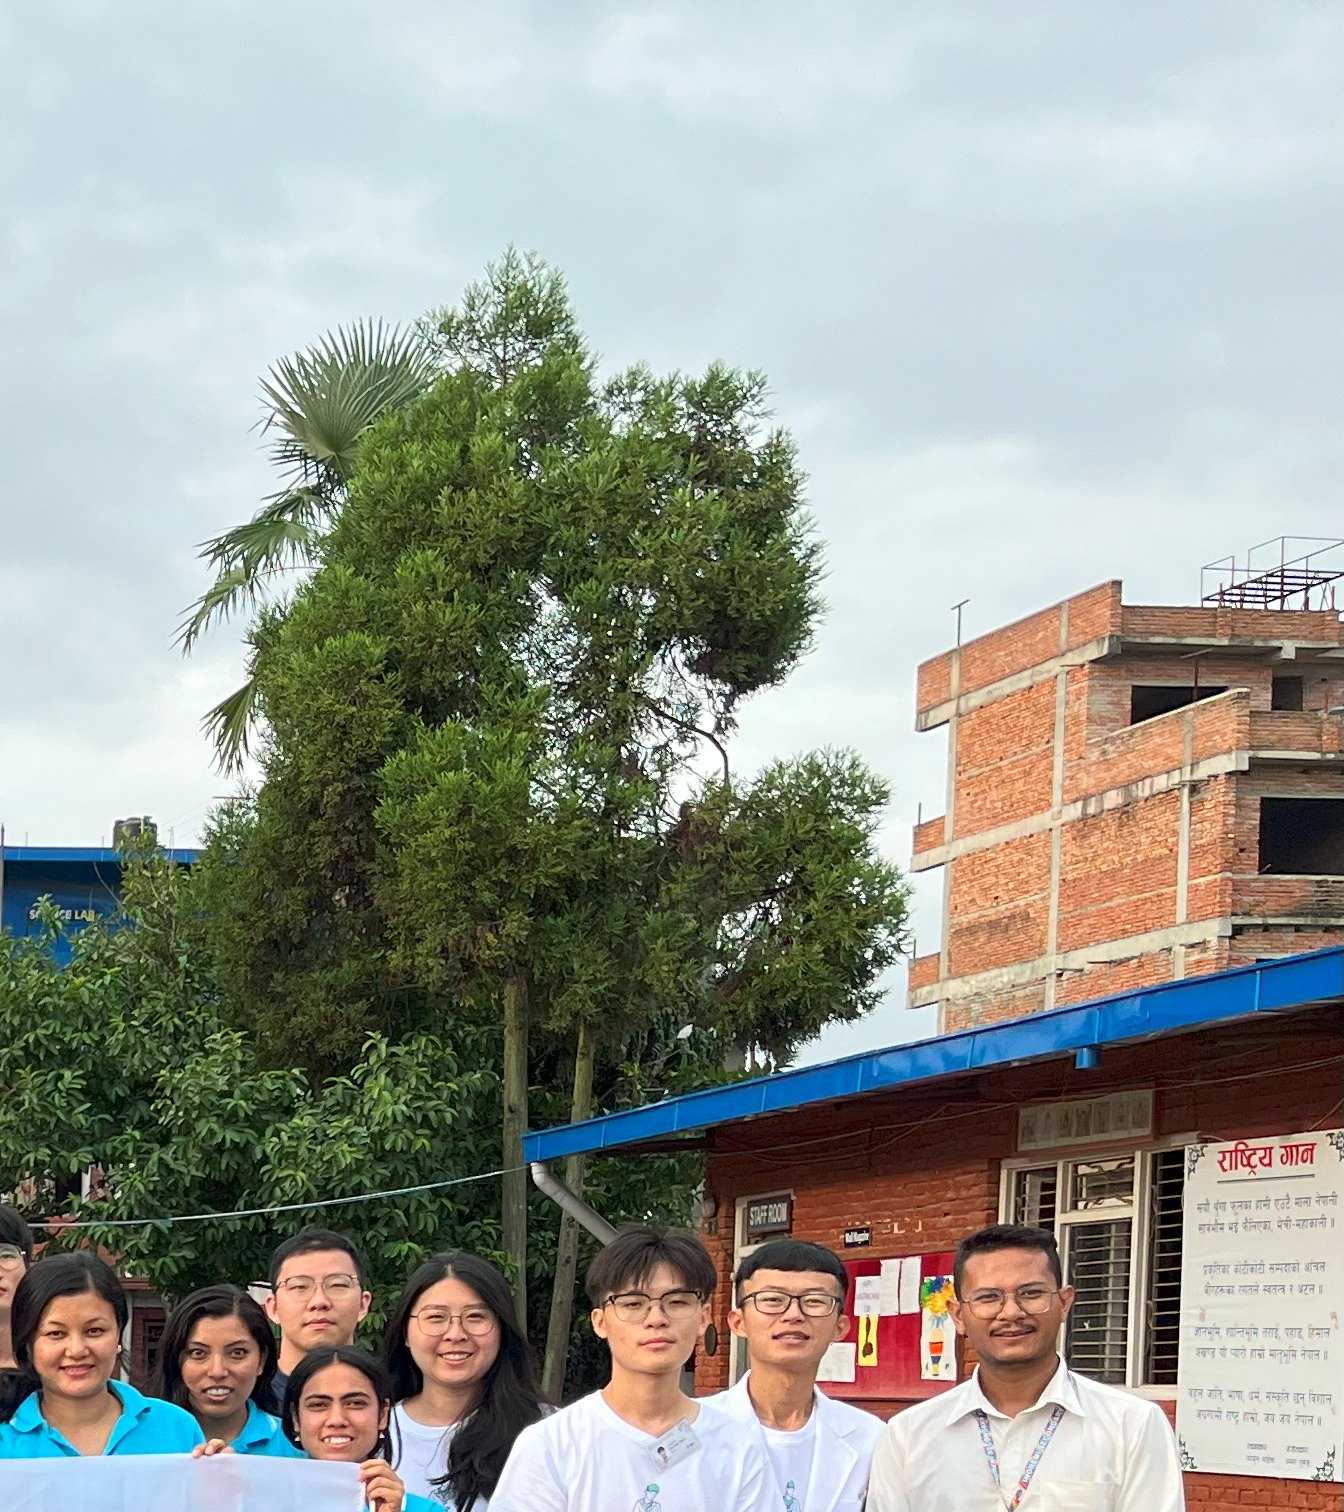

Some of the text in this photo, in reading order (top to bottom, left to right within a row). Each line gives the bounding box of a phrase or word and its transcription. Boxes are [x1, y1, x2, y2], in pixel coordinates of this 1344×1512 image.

[1217, 1141, 1317, 1175] राष्ट्रिय गान
[749, 1202, 787, 1226] STAFF ROOM
